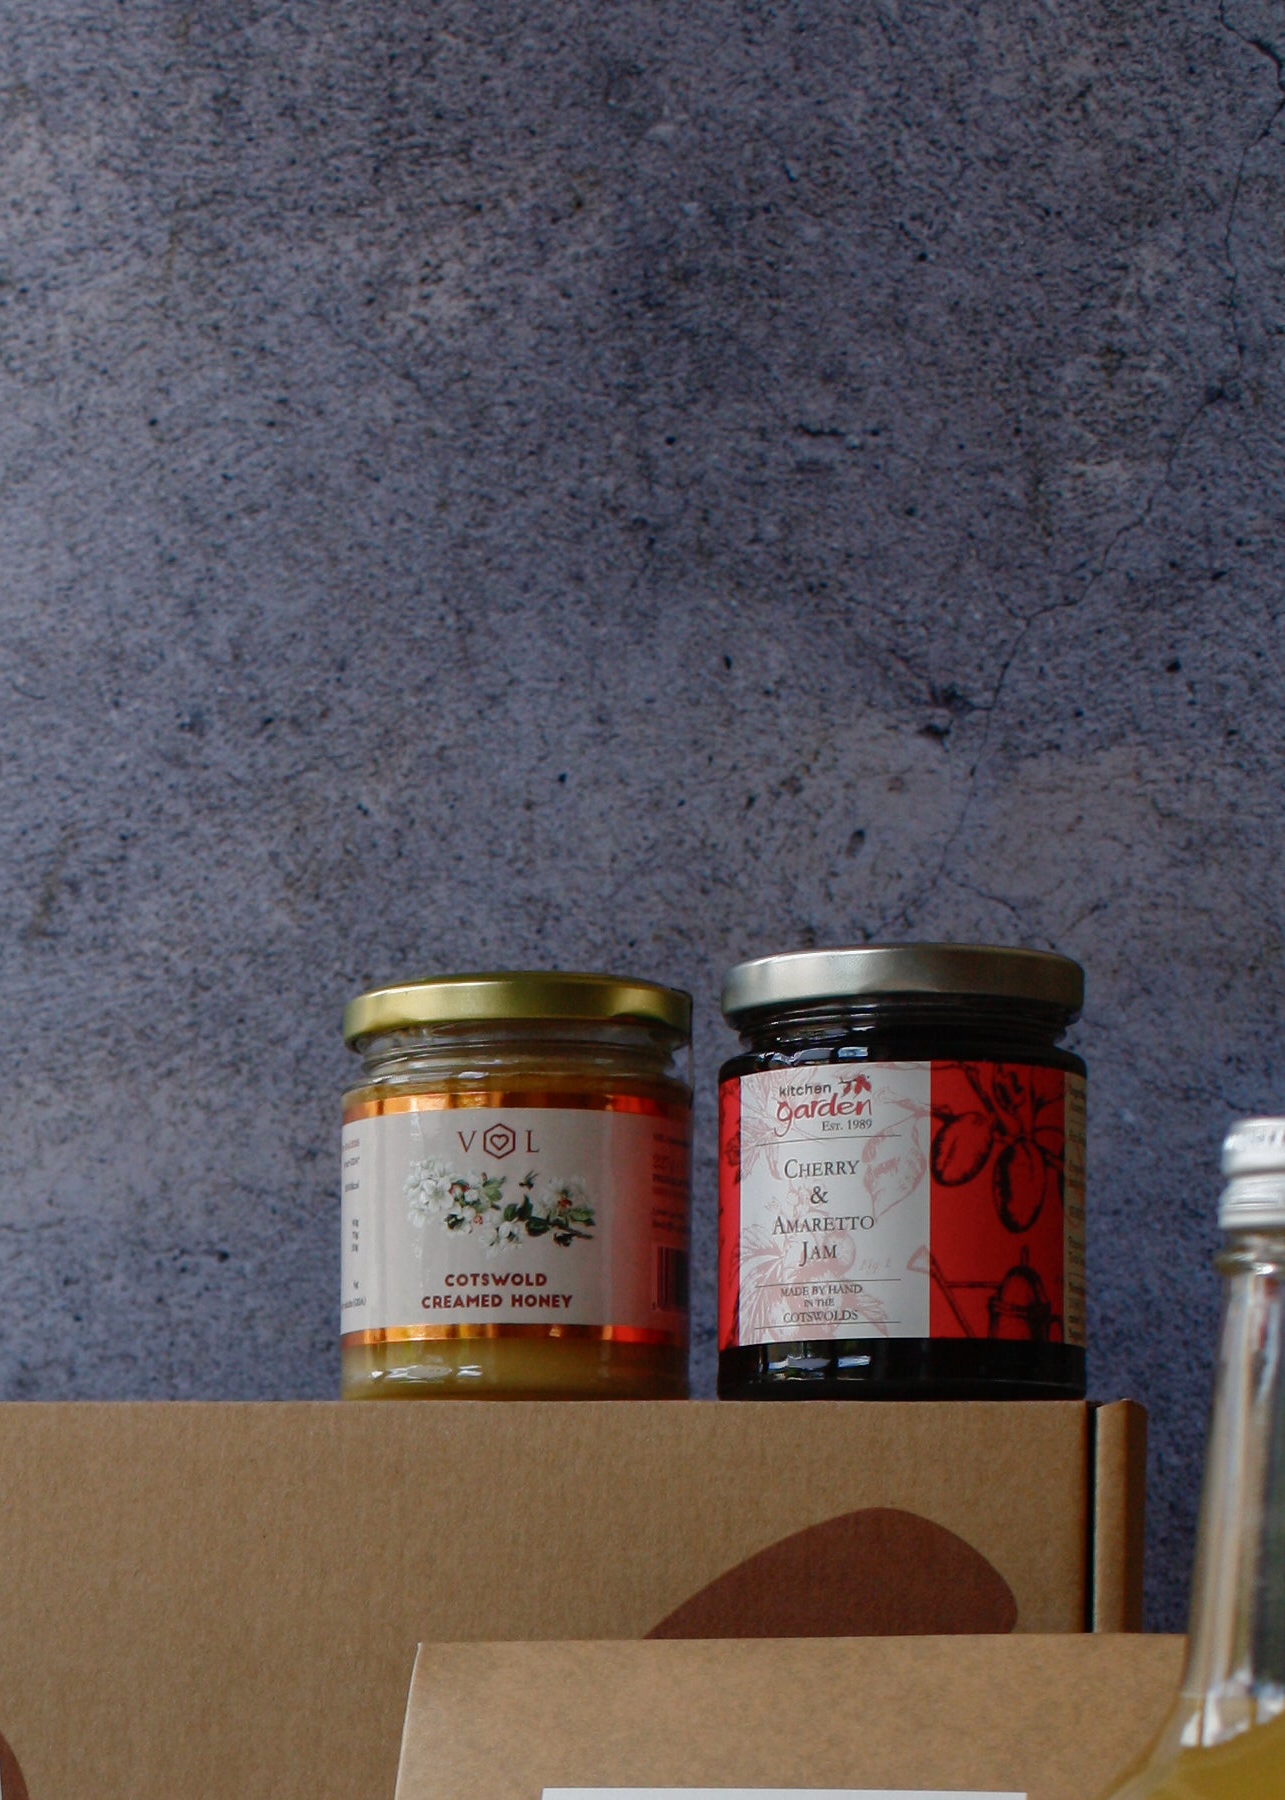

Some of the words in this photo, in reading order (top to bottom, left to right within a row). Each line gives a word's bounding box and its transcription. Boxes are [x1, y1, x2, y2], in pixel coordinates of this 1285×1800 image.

[778, 1083, 832, 1097] kitchen
[774, 1093, 873, 1137] garden
[847, 1119, 873, 1130] 1989
[810, 1186, 829, 1204] &
[444, 1273, 548, 1288] COTSWOLD
[780, 1286, 810, 1297] MADE
[811, 1285, 827, 1296] BY
[828, 1284, 863, 1295] HAND
[421, 1294, 503, 1309] CREAMED
[510, 1294, 574, 1309] HONEY
[803, 1299, 814, 1308] IN
[816, 1298, 835, 1307] THE
[783, 1309, 859, 1322] COTSWOLDS
